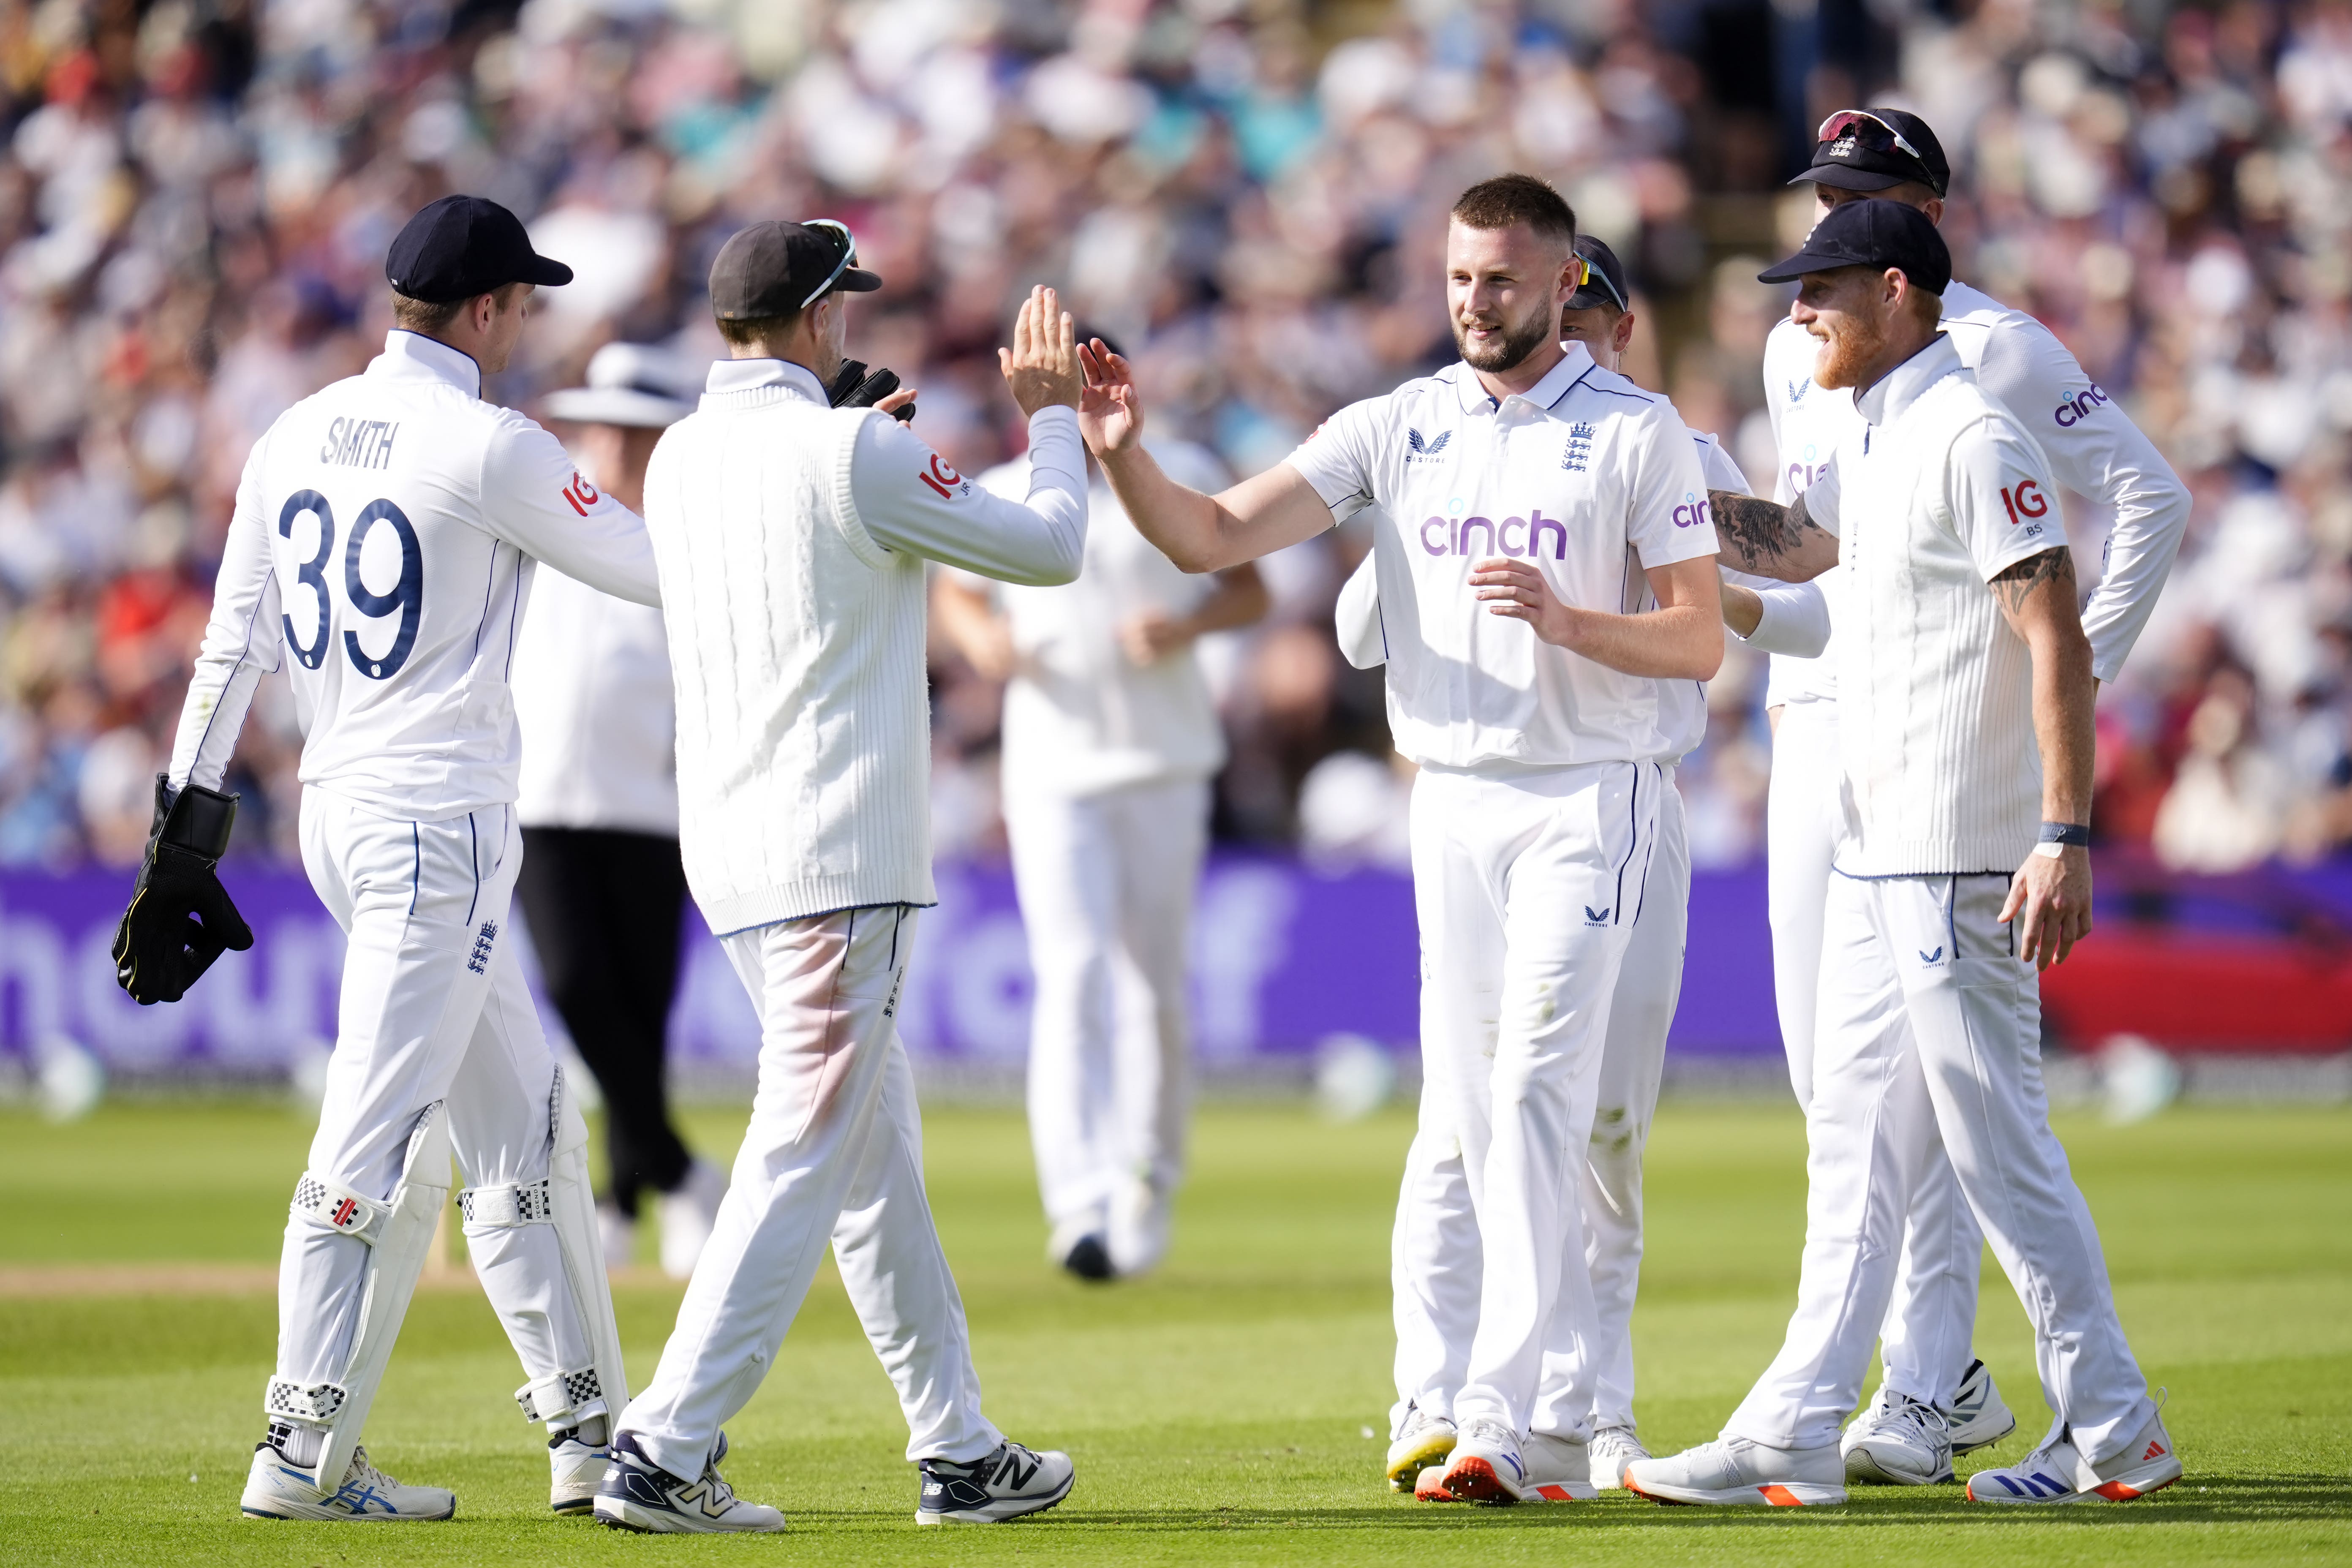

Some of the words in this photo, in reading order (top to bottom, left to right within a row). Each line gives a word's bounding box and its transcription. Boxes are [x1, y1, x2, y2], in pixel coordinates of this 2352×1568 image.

[2055, 383, 2107, 427] cinc
[320, 416, 400, 470] SMITH
[562, 471, 598, 517] IG
[919, 454, 960, 500] IG
[961, 482, 971, 496] JR
[1673, 493, 1710, 528] cin
[2001, 480, 2048, 525] IG
[1420, 498, 1567, 560] cinch
[2027, 524, 2042, 536] BS
[279, 489, 423, 680] 39
